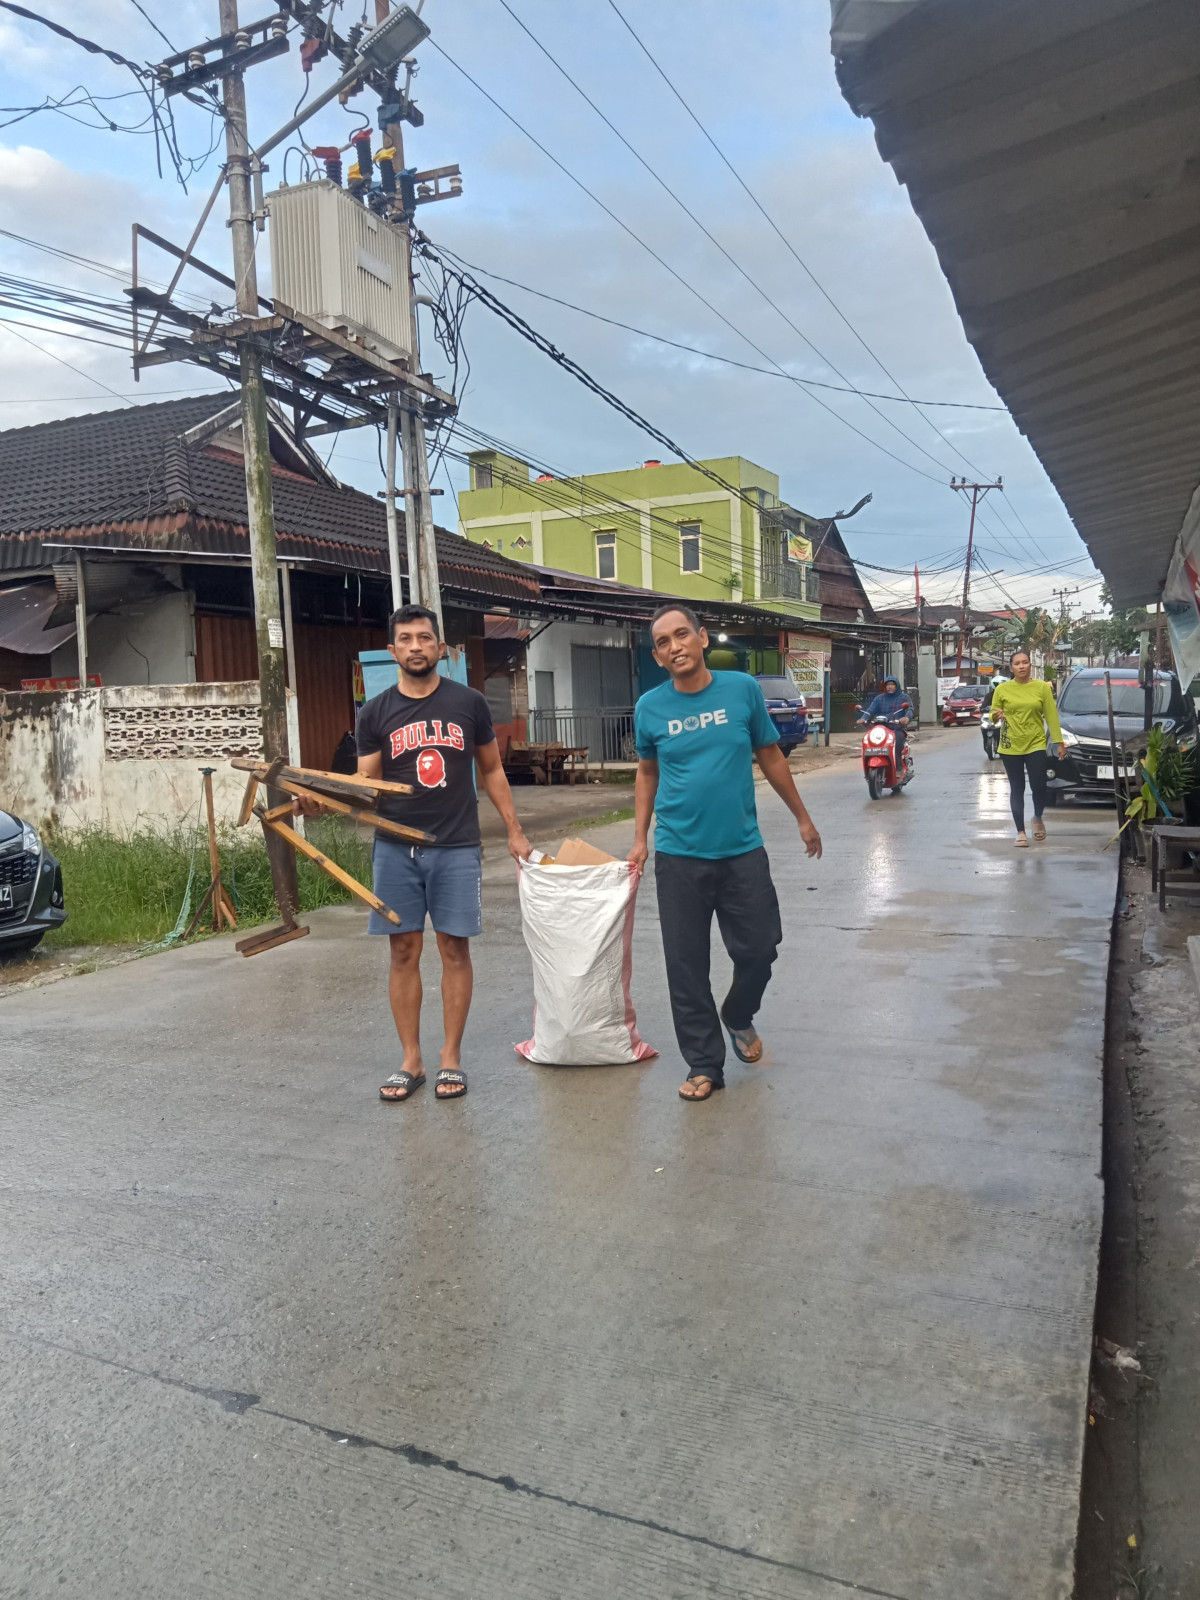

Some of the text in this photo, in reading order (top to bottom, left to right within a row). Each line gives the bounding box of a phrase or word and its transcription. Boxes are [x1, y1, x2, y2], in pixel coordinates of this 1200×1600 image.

[793, 671, 818, 681] TENUN
[668, 708, 728, 735] DOPE
[390, 719, 465, 760] BULLS
